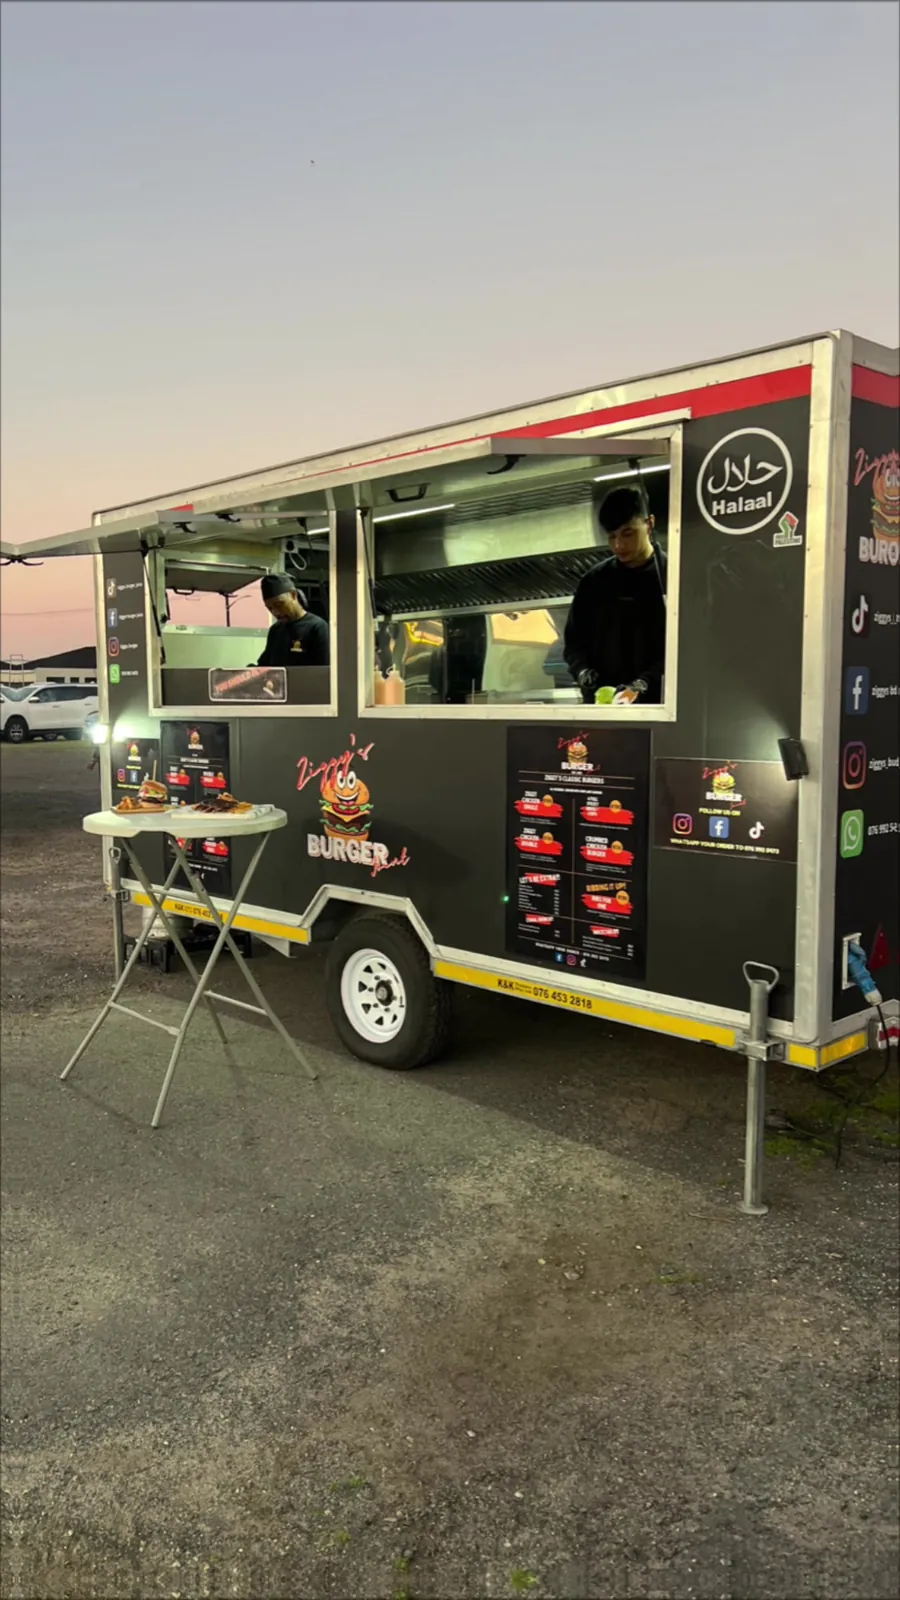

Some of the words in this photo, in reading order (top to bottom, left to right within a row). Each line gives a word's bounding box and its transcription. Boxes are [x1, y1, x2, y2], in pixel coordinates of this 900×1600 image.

[707, 454, 783, 494] حلال
[712, 491, 773, 516] Halaal
[561, 761, 594, 771] BURGER
[699, 807, 722, 816] FOLLOW
[307, 833, 389, 866] BURGER
[670, 838, 700, 846] WHATSAPP
[497, 978, 514, 991] K&K
[532, 987, 549, 998] 076
[551, 990, 568, 1003] 453
[569, 995, 593, 1009] 2818
